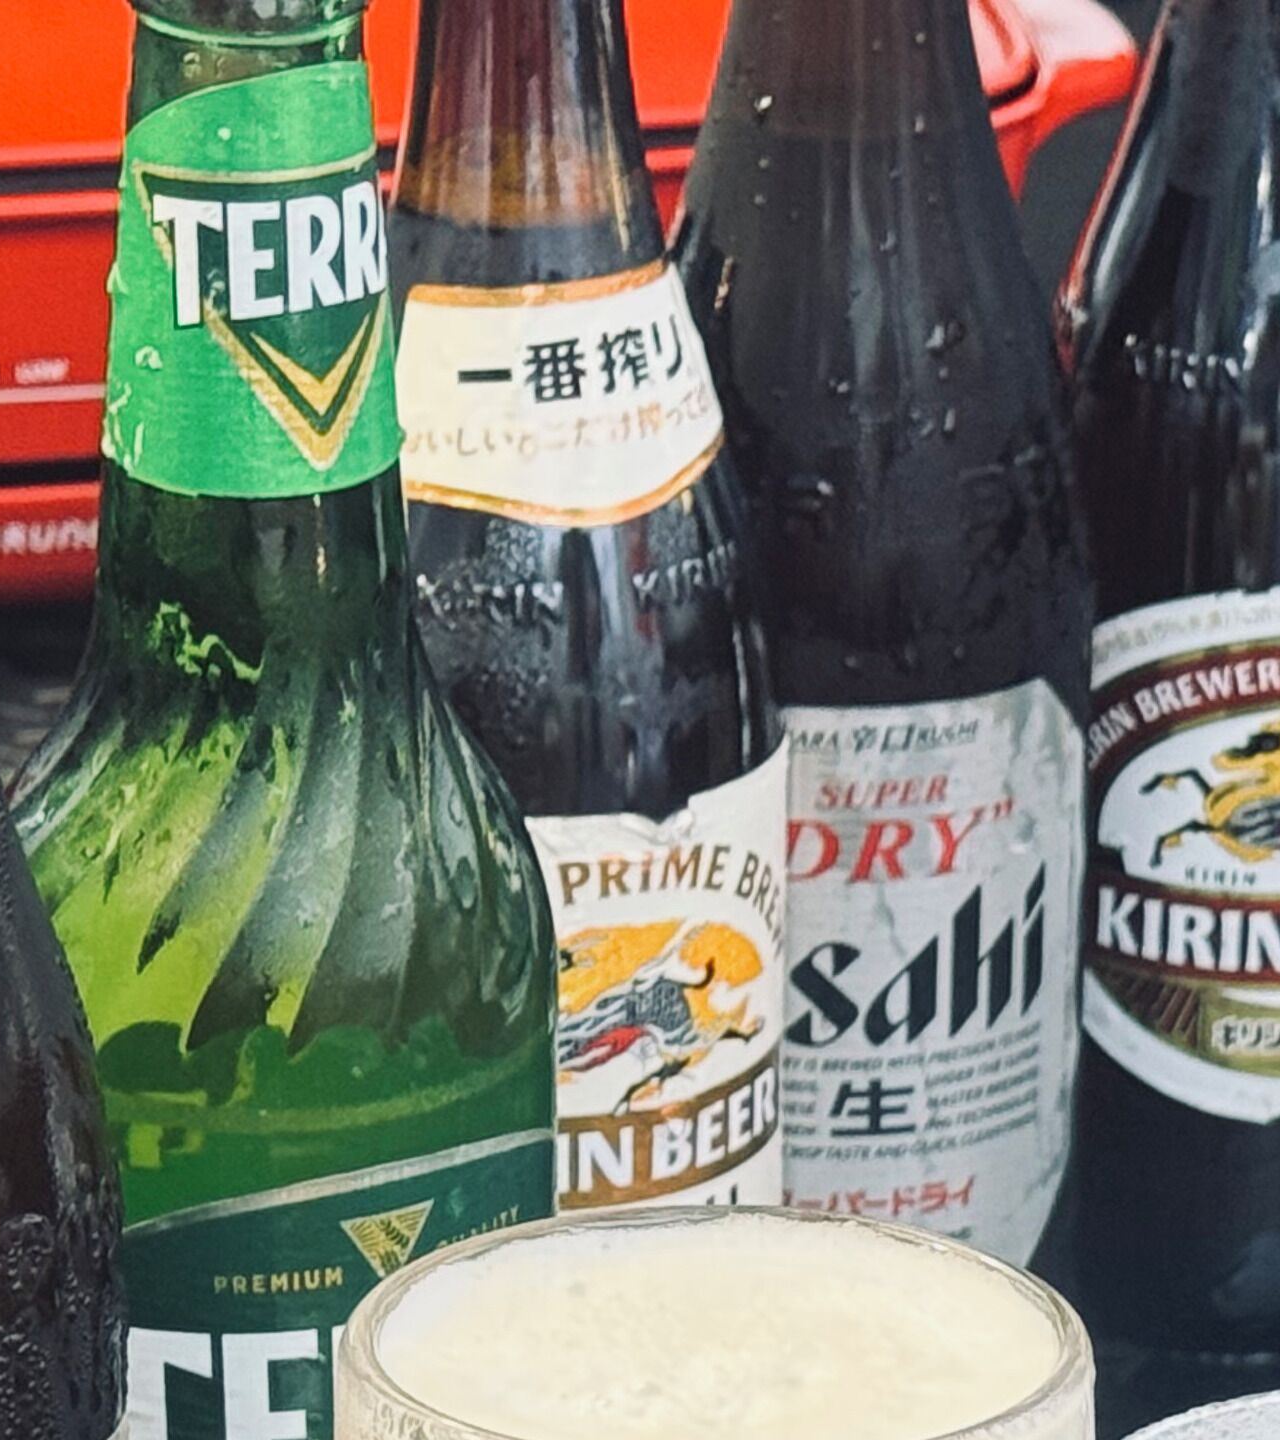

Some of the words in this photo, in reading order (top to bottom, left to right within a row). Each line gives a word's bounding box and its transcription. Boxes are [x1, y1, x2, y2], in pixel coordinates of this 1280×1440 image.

[457, 315, 684, 404] 一番搾り
[816, 775, 950, 810] SUPER
[557, 844, 730, 907] PRIME
[651, 1065, 777, 1182] BEER
[830, 1076, 917, 1139] 生
[213, 1266, 345, 1296] PREMIUM
